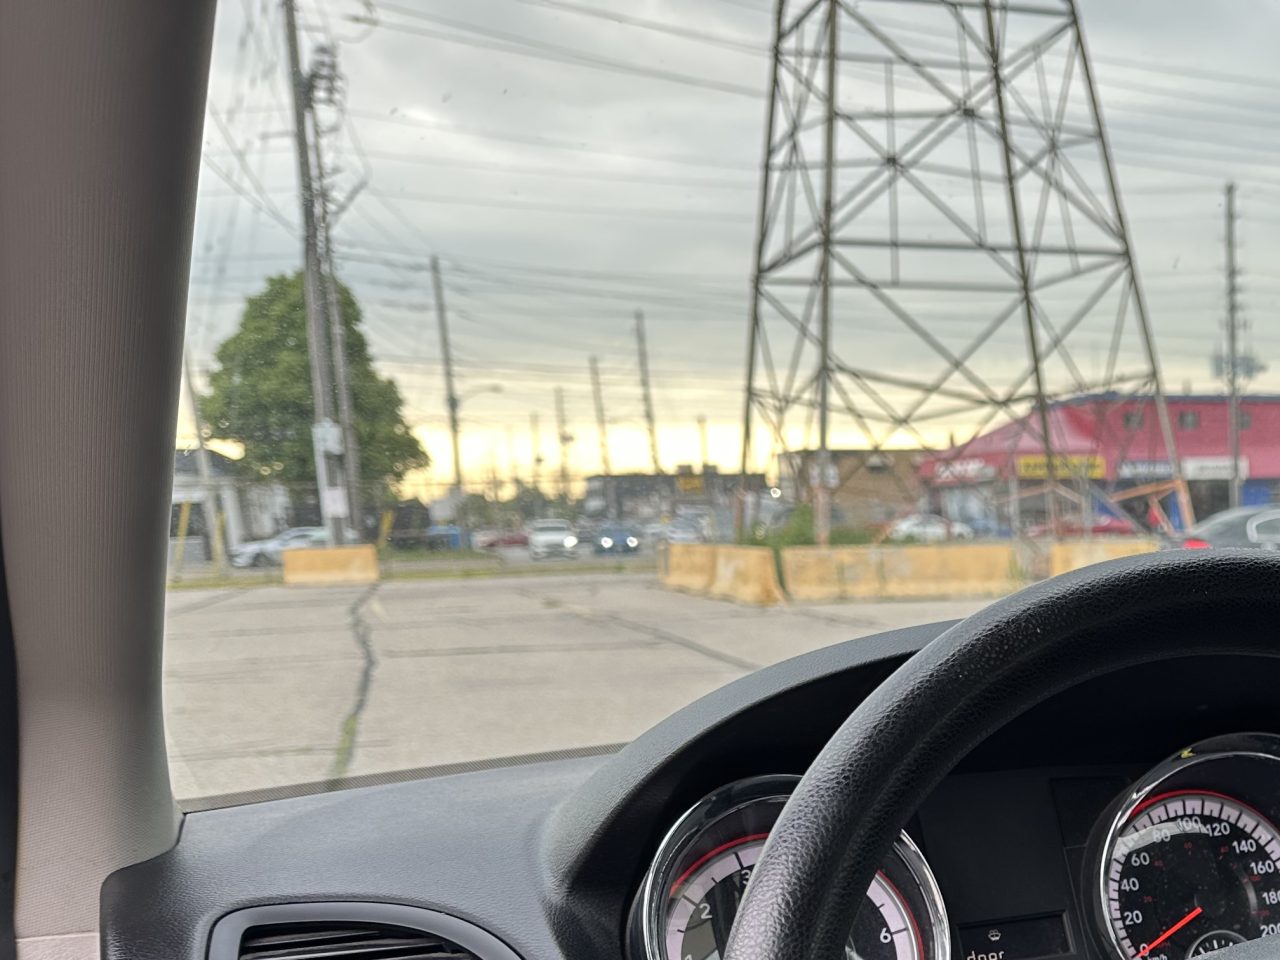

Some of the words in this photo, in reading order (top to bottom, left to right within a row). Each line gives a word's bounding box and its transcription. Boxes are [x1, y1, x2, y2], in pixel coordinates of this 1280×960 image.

[1176, 816, 1201, 832] 100
[1207, 824, 1230, 837] 120
[1152, 829, 1171, 843] 80
[1232, 839, 1257, 854] 140
[1131, 852, 1150, 867] 60
[1250, 860, 1275, 875] 160
[1121, 878, 1139, 893] 40
[700, 902, 713, 920] 2
[1124, 910, 1143, 926] 20
[879, 927, 892, 944] 6
